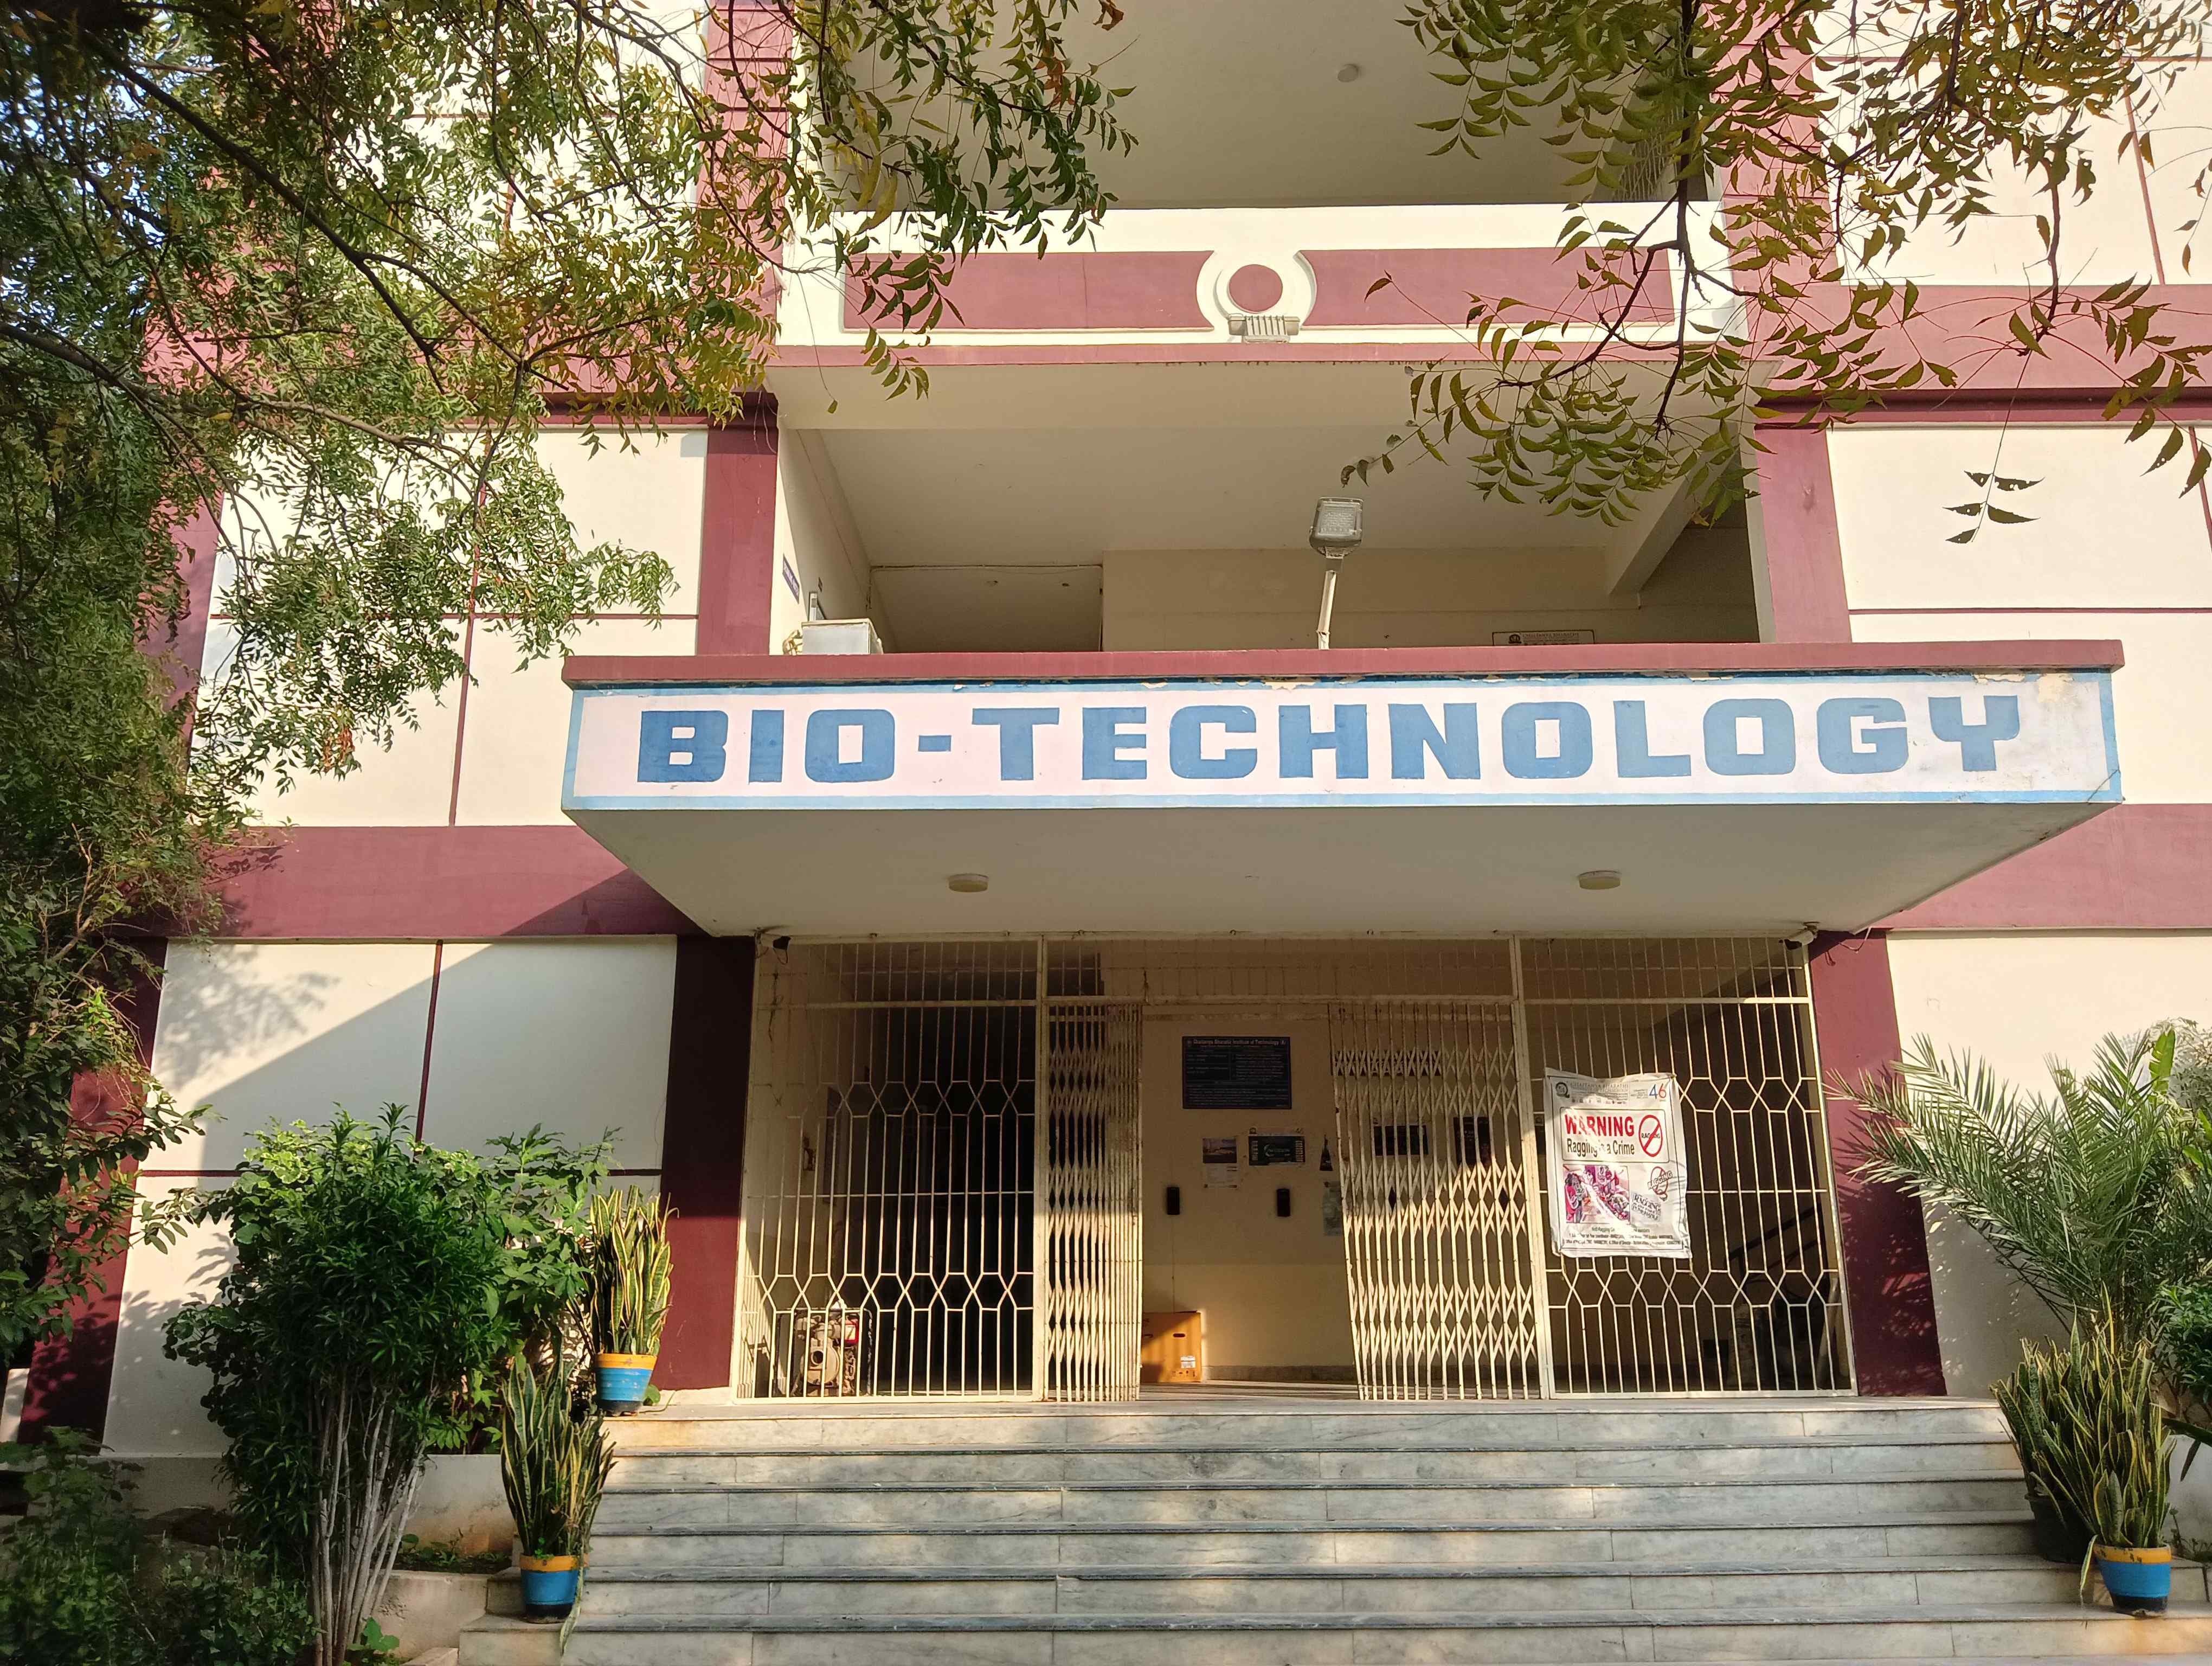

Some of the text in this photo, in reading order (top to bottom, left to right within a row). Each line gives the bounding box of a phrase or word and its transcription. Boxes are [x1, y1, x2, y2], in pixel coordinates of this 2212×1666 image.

[637, 695, 2020, 783] BIO-TECHNOLOGY
[1649, 1082, 1667, 1099] 46
[1565, 1113, 1635, 1137] WARNING
[1567, 1138, 1598, 1157] Ragging
[1606, 1143, 1612, 1155] a
[1612, 1139, 1635, 1155] Crime
